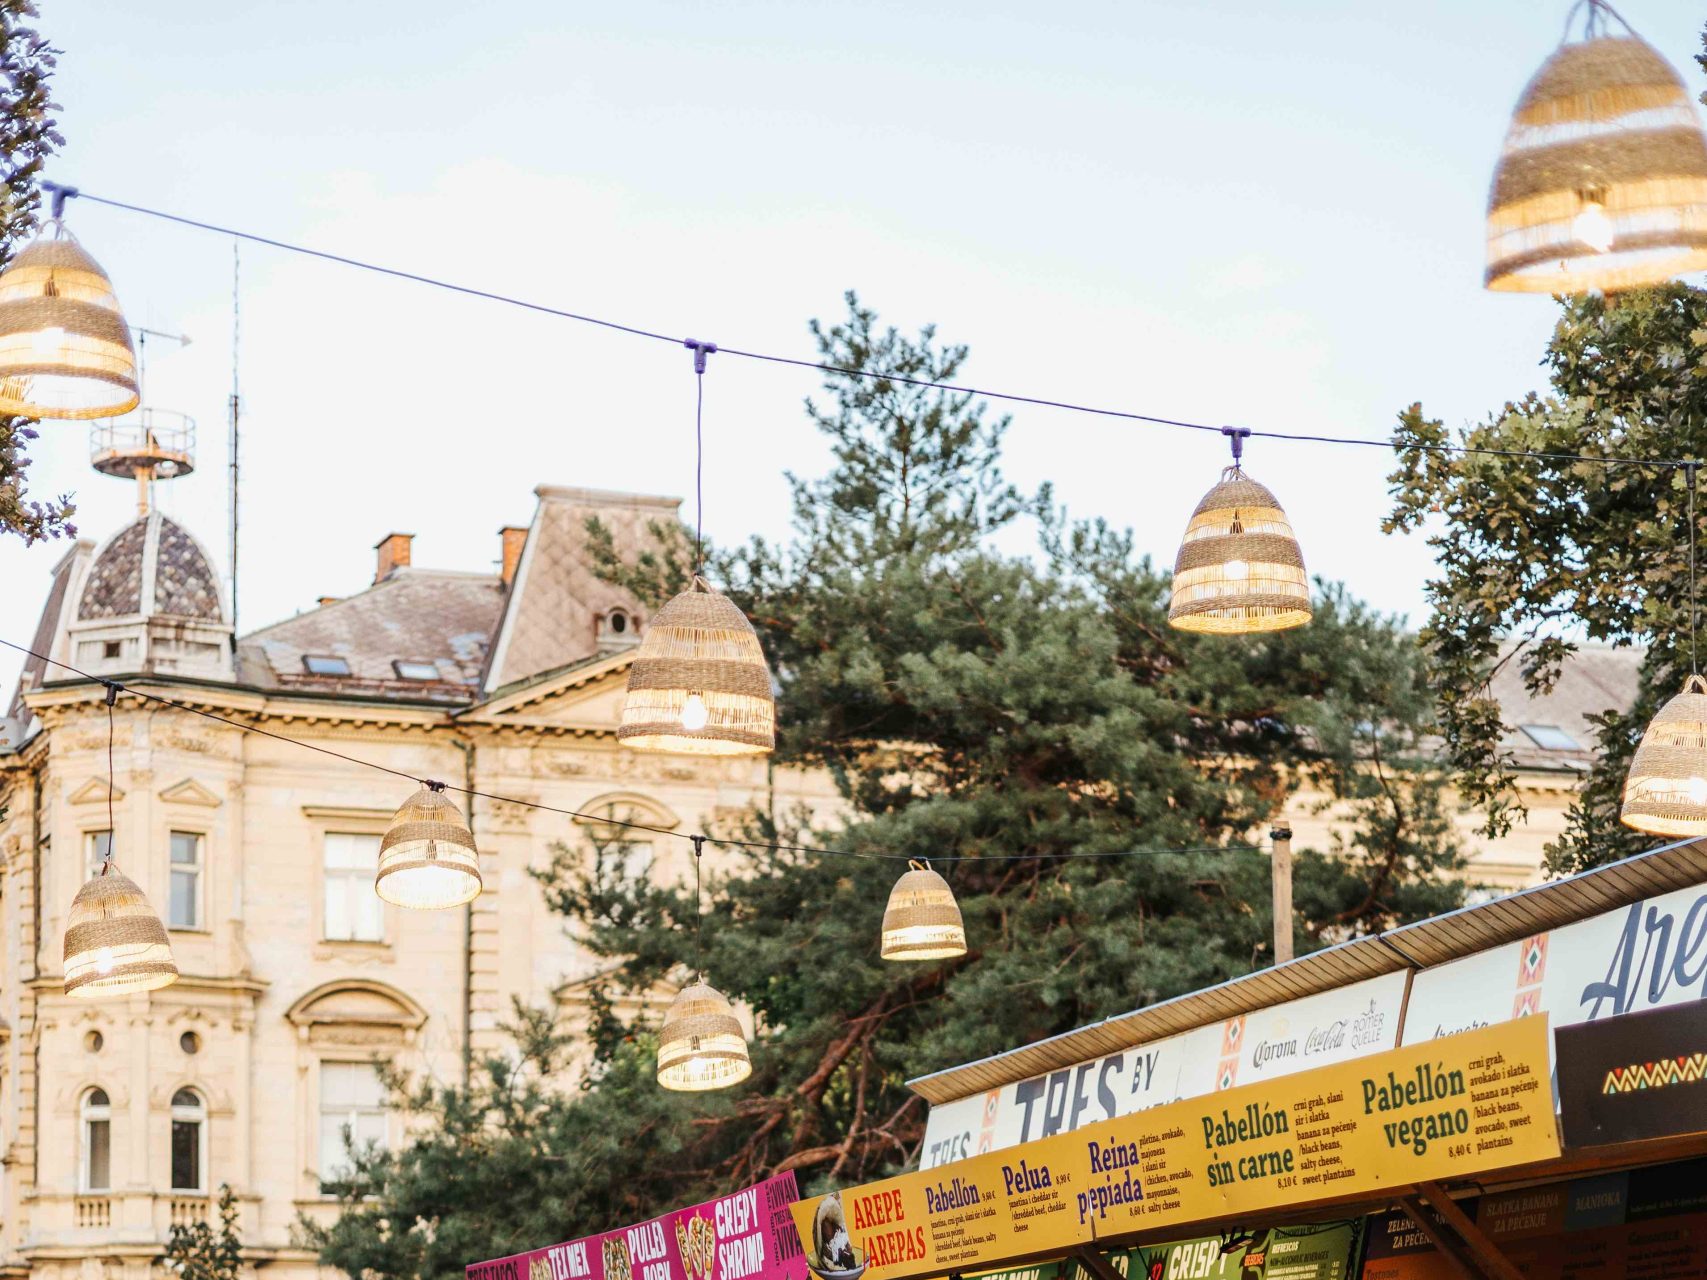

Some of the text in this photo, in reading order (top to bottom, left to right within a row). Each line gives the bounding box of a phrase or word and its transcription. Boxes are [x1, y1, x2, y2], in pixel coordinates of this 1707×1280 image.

[1580, 895, 1707, 1021] Are
[1253, 1039, 1297, 1069] Corona
[1351, 1028, 1382, 1050] QUELLE
[1131, 1050, 1159, 1094] BY
[1361, 1061, 1466, 1115] Pabellón
[1470, 1071, 1501, 1087] avokado
[1507, 1063, 1530, 1078] slatka
[1327, 1090, 1344, 1104] slani
[1471, 1088, 1499, 1103] banana
[1500, 1086, 1510, 1097] za
[1201, 1101, 1289, 1149] Pabellón
[1296, 1128, 1321, 1140] banana
[1322, 1127, 1330, 1136] za
[1309, 1110, 1330, 1123] slatka
[1384, 1108, 1469, 1156] vegano
[1509, 1114, 1532, 1128] sweet
[1088, 1135, 1140, 1174] Reina
[1300, 1157, 1317, 1171] salty
[1476, 1136, 1514, 1155] plantains
[1001, 1159, 1052, 1196] Pelua
[1207, 1149, 1295, 1187] sin carne
[1302, 1167, 1356, 1185] sweet plantains
[715, 1189, 759, 1239] CRISPY
[854, 1189, 905, 1230] AREPE
[926, 1177, 980, 1214] Pabellón
[1077, 1169, 1144, 1225] pepiada
[566, 1241, 591, 1278] MEX
[627, 1221, 667, 1265] PULLED
[1392, 1236, 1403, 1249] ZA
